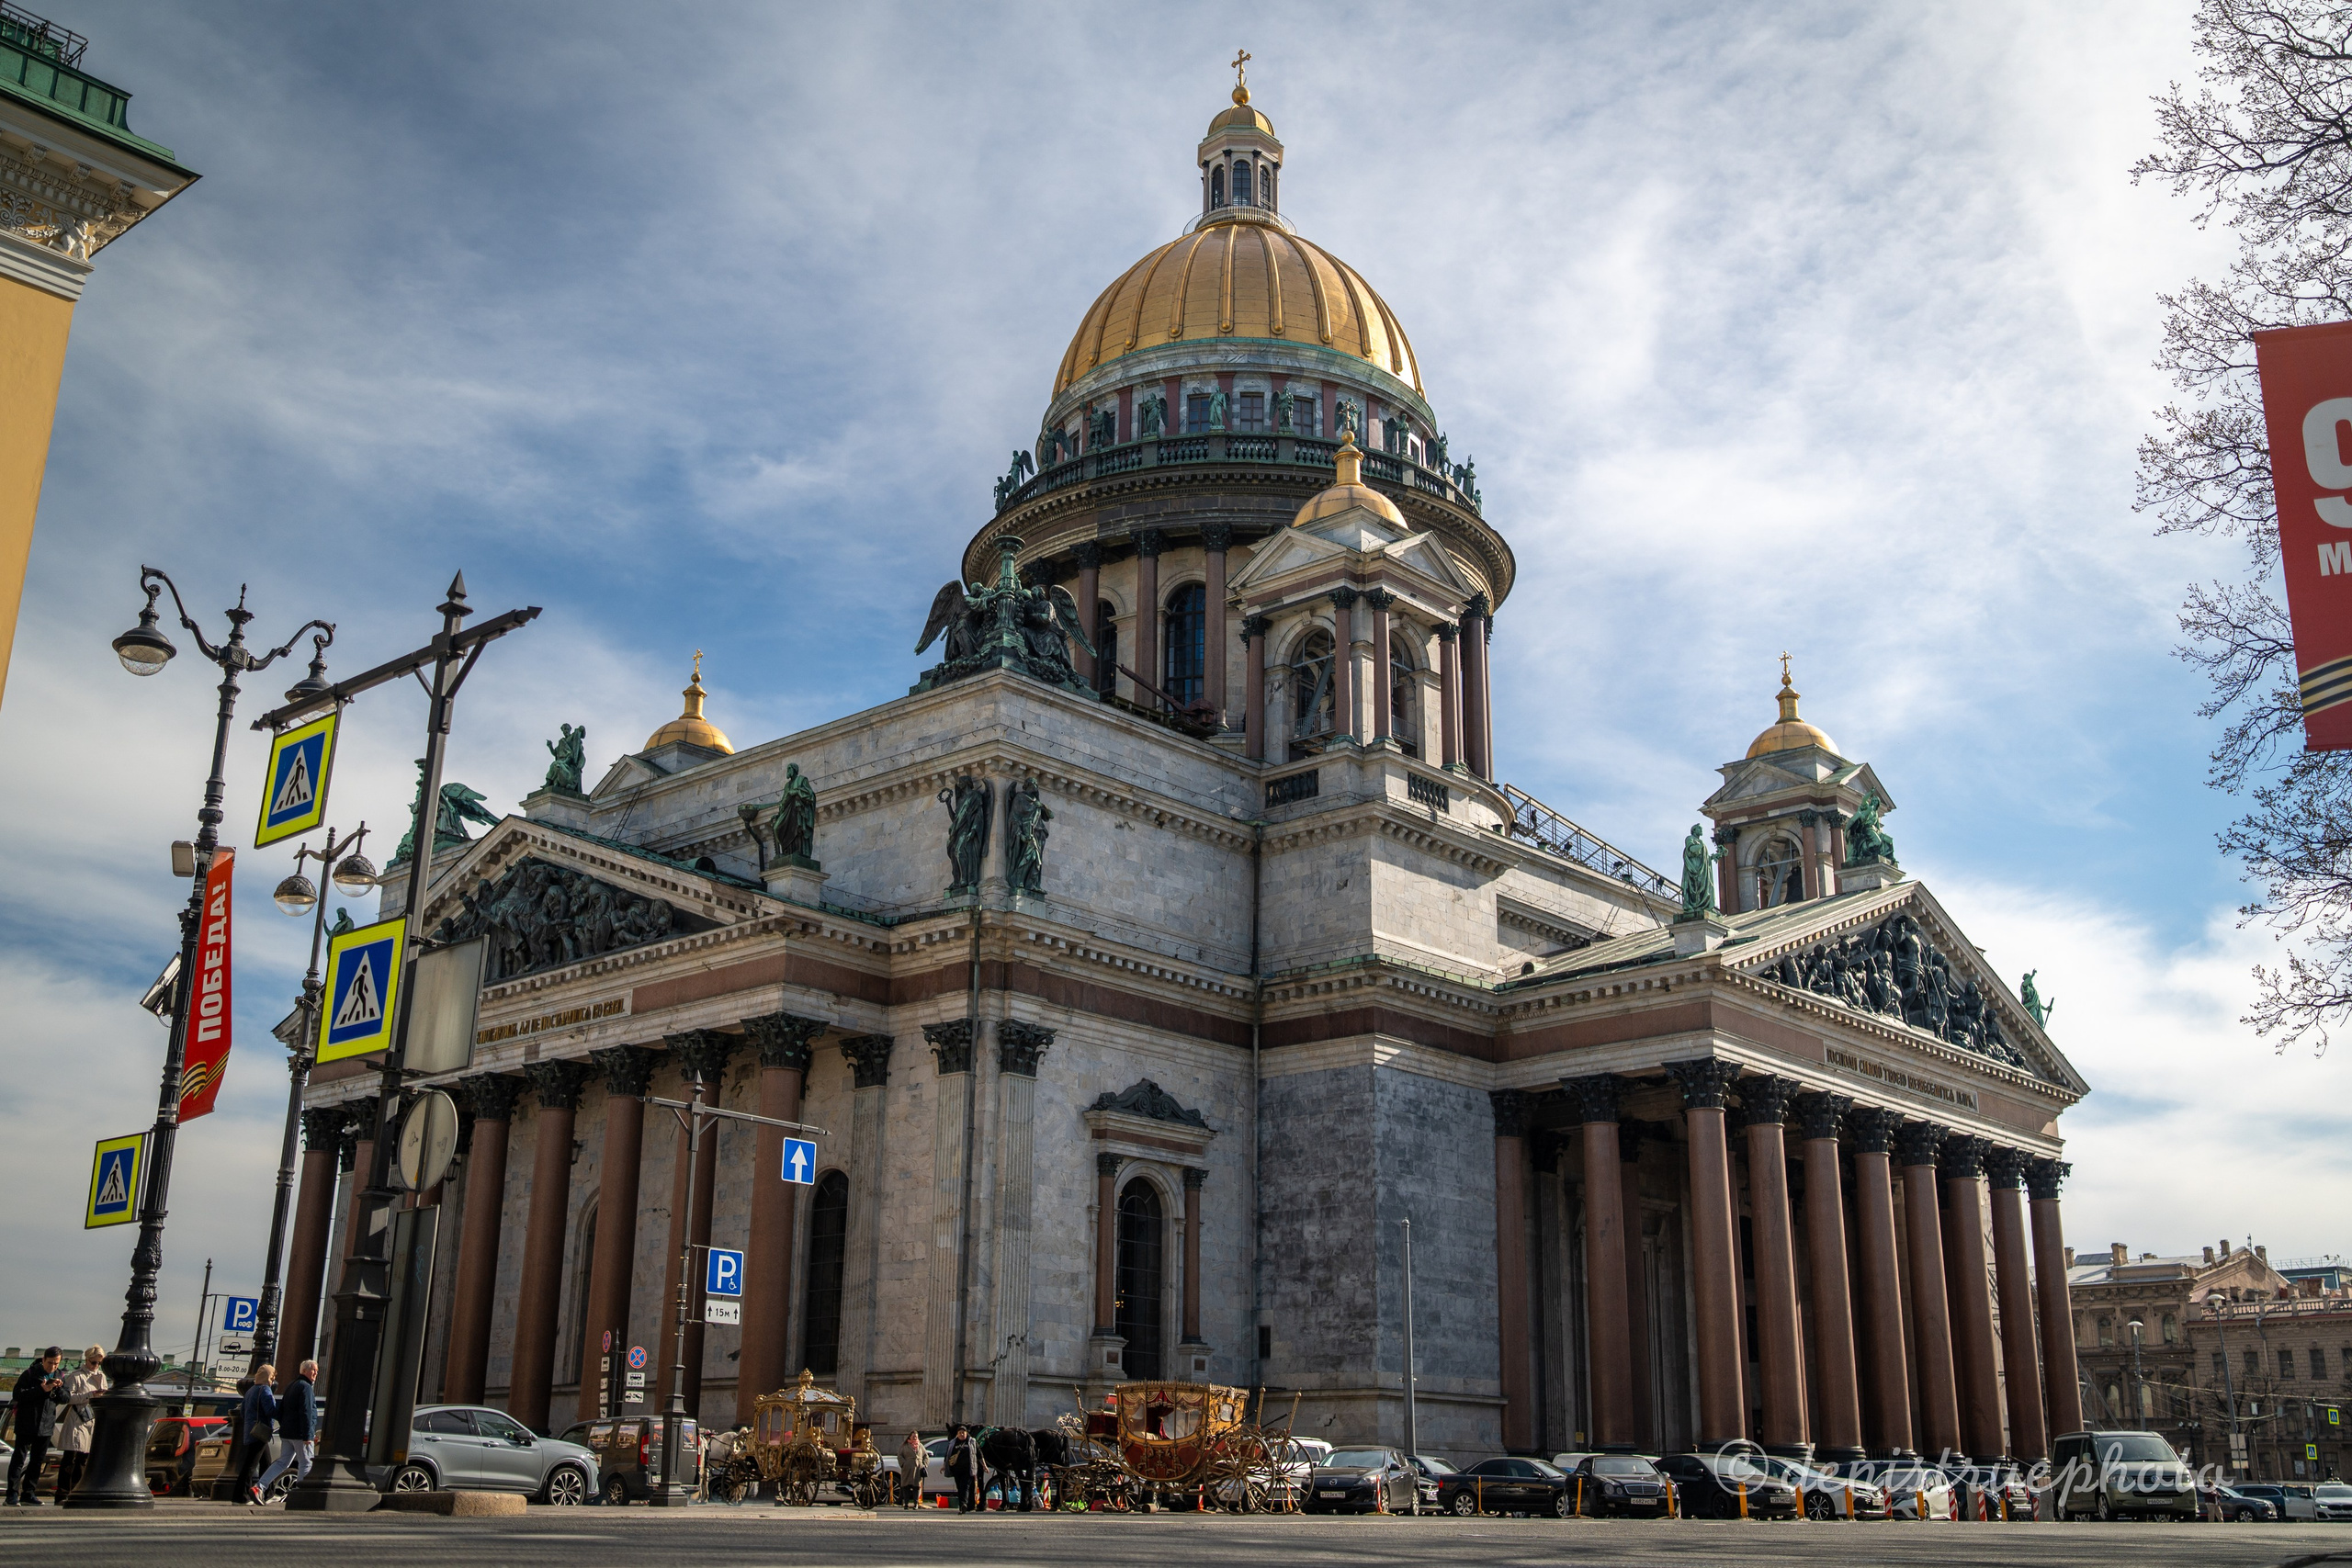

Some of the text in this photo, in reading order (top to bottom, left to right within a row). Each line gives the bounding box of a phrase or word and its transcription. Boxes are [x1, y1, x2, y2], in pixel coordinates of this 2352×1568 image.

[198, 880, 227, 1043] ПОБЕДА!
[717, 1255, 736, 1289] P
[232, 1301, 252, 1327] P
